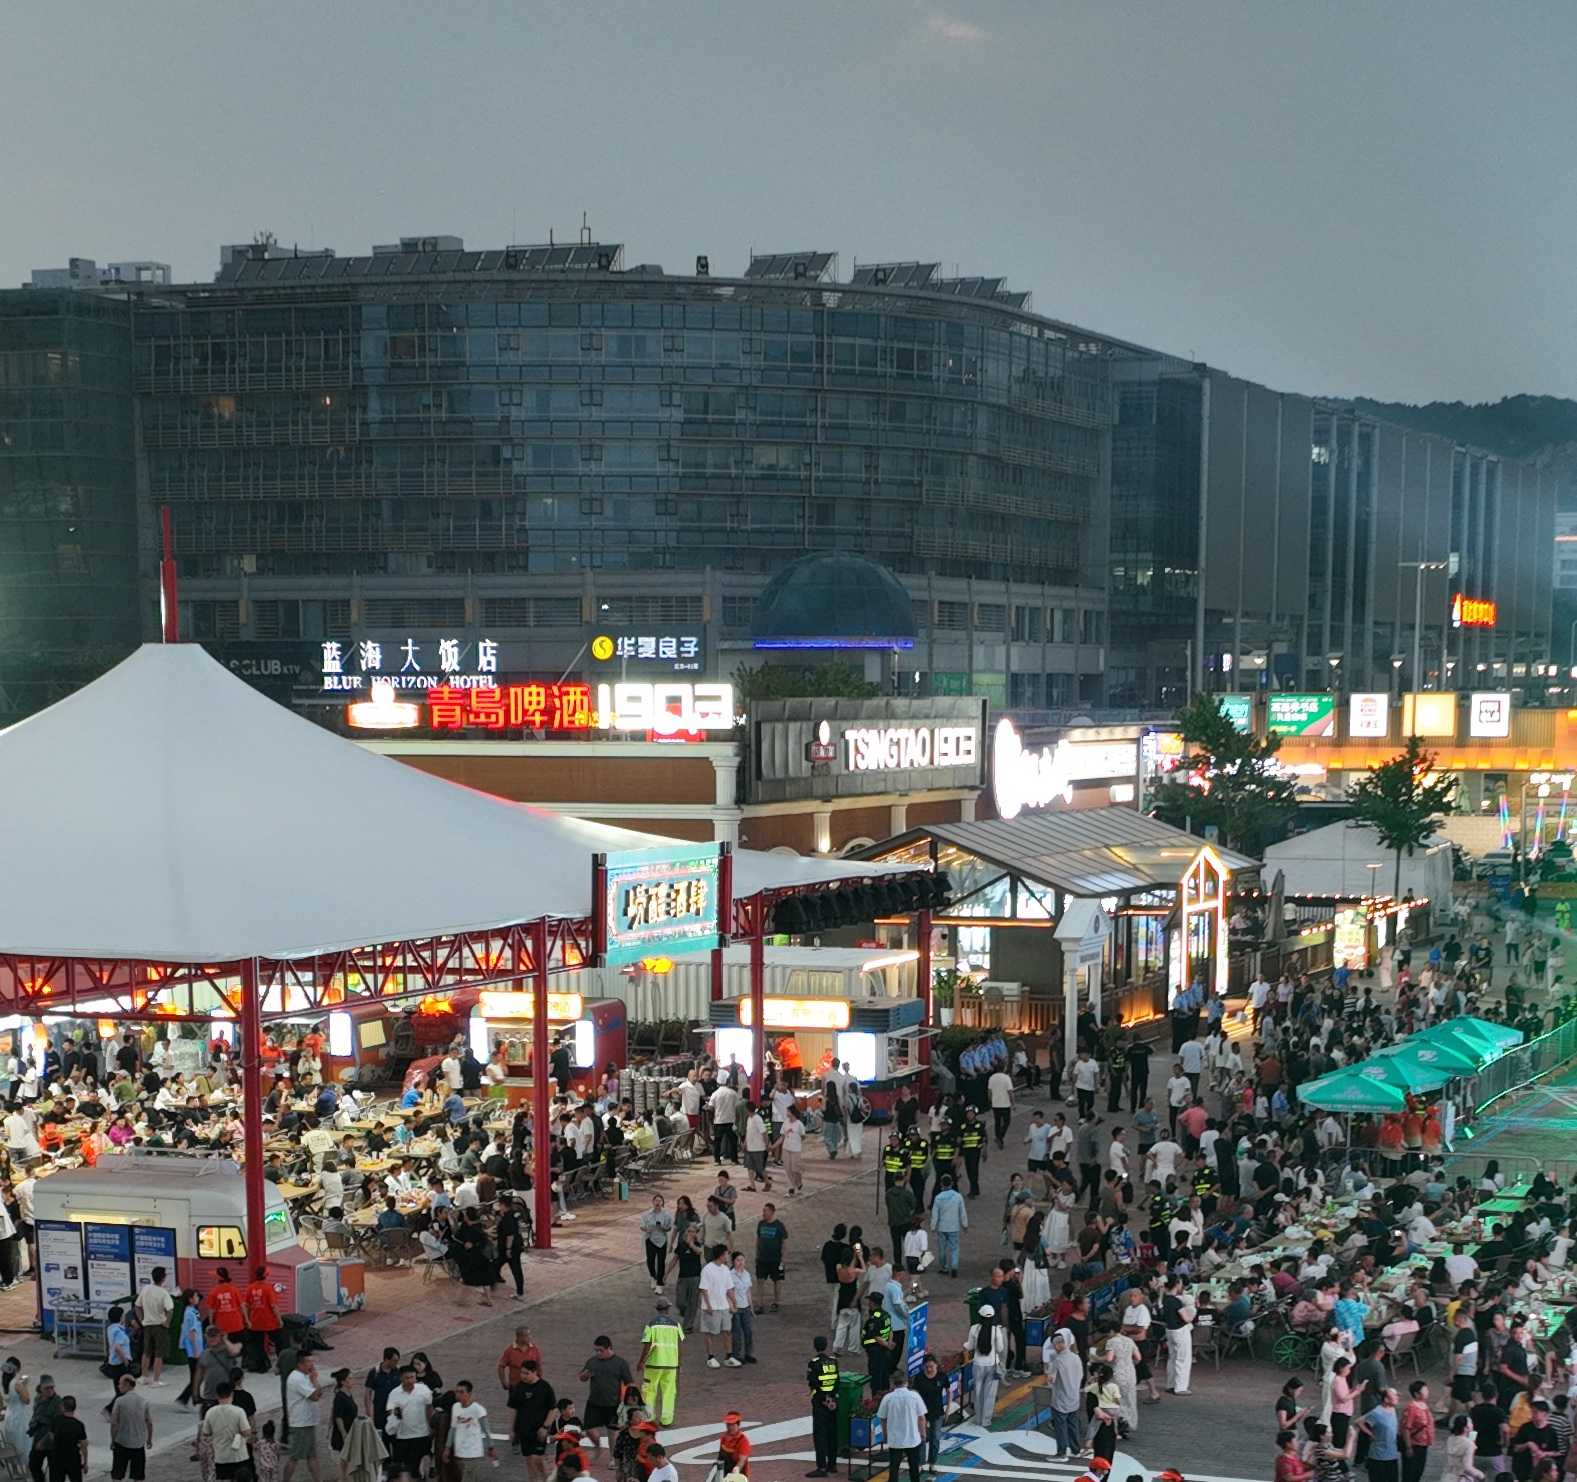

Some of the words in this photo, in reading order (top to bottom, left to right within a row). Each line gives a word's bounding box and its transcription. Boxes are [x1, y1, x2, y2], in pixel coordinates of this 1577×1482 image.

[321, 638, 499, 673] 蓝海大饭店
[616, 636, 699, 659] 华夏良子
[844, 728, 930, 772] TSINGTAO
[933, 727, 976, 766] 1903
